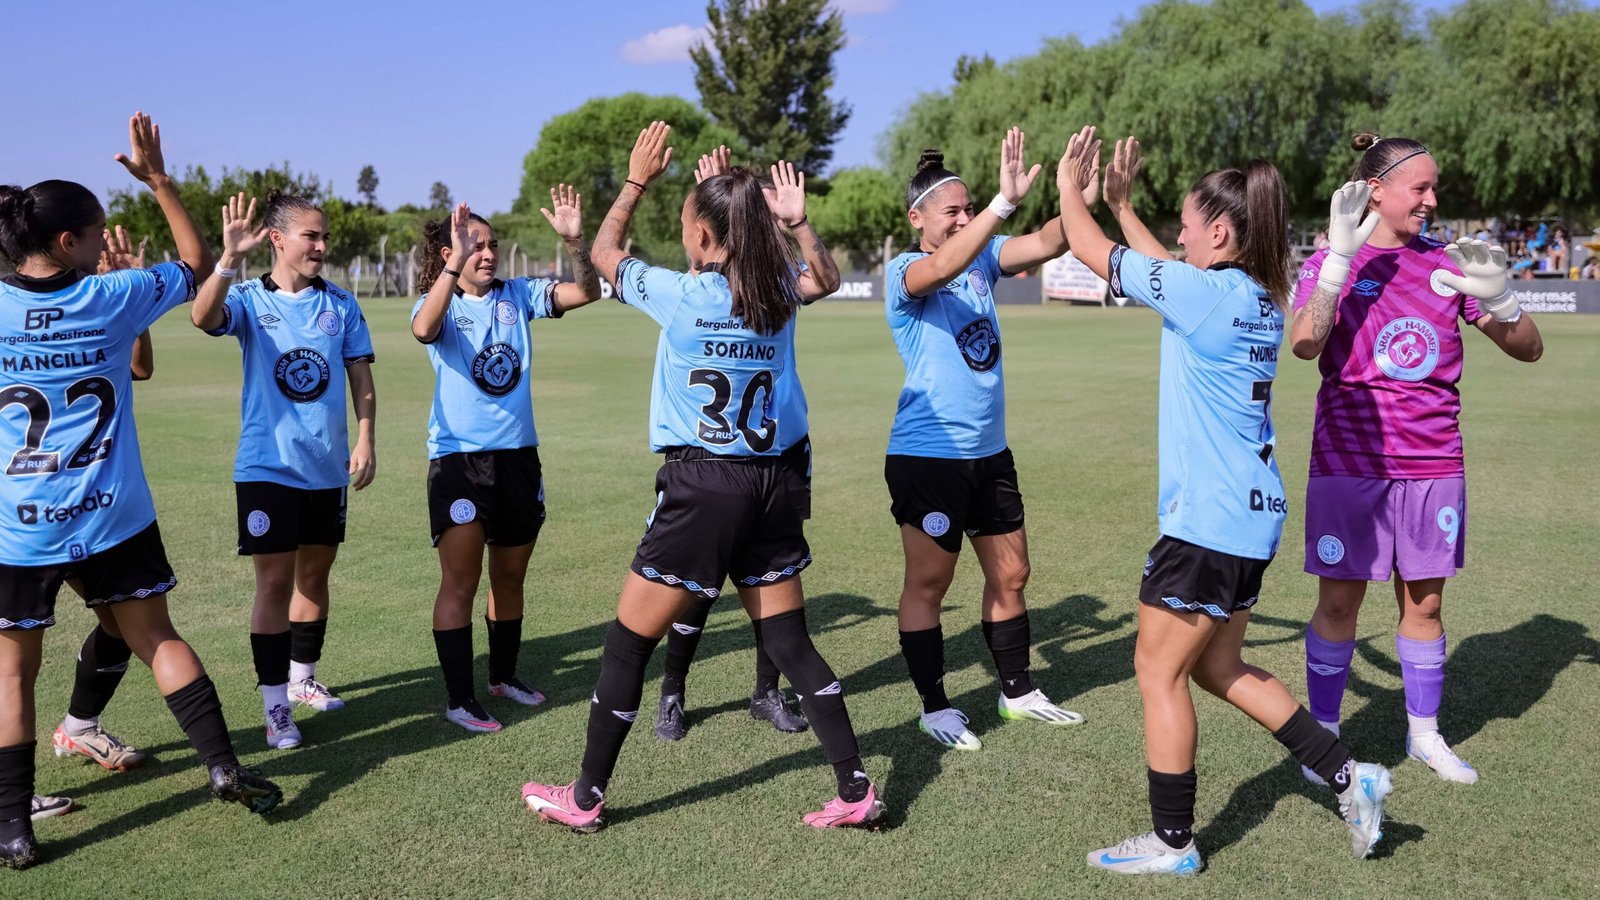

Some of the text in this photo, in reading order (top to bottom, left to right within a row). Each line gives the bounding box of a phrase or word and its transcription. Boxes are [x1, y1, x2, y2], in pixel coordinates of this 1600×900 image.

[695, 318, 740, 331] Bergallo
[1232, 317, 1268, 332] Bergallo
[0, 328, 106, 345] ergallo & Pastrone
[1378, 321, 1436, 355] ARM & HAMMER
[2, 348, 107, 371] MANCILLA
[703, 341, 776, 360] SORIANO
[276, 350, 329, 380] ARM & HAMMER
[475, 357, 485, 379] ARM
[687, 367, 777, 454] 30
[0, 375, 118, 477] 22
[715, 431, 734, 439] RUS
[28, 460, 48, 468] RUS
[1437, 505, 1459, 545] 9
